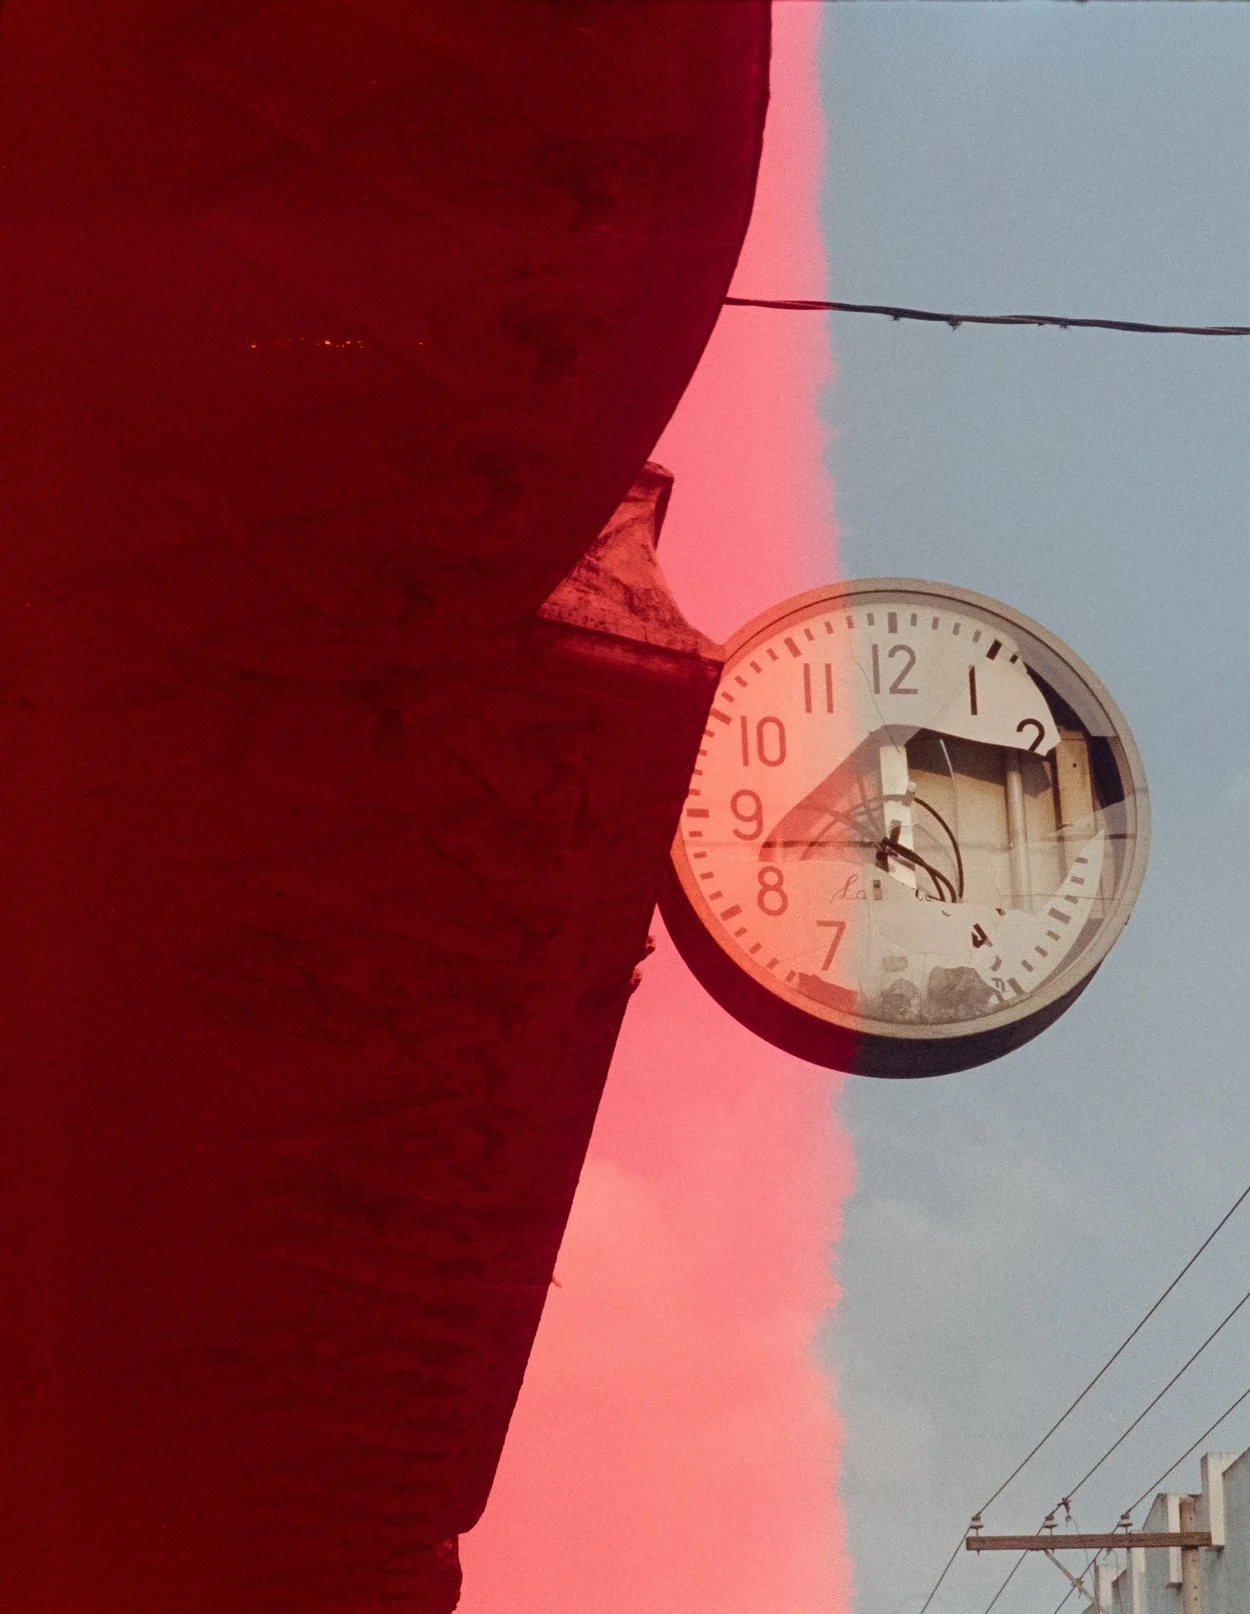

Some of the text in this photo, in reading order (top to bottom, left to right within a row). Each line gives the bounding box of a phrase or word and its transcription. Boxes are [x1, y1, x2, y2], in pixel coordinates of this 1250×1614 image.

[803, 662, 835, 714] 11
[871, 643, 919, 696] 12
[967, 664, 979, 716] 1
[740, 715, 787, 768] 10
[1016, 718, 1045, 752] 2
[730, 789, 764, 841] 9
[757, 865, 789, 917] 8
[816, 920, 847, 972] 7
